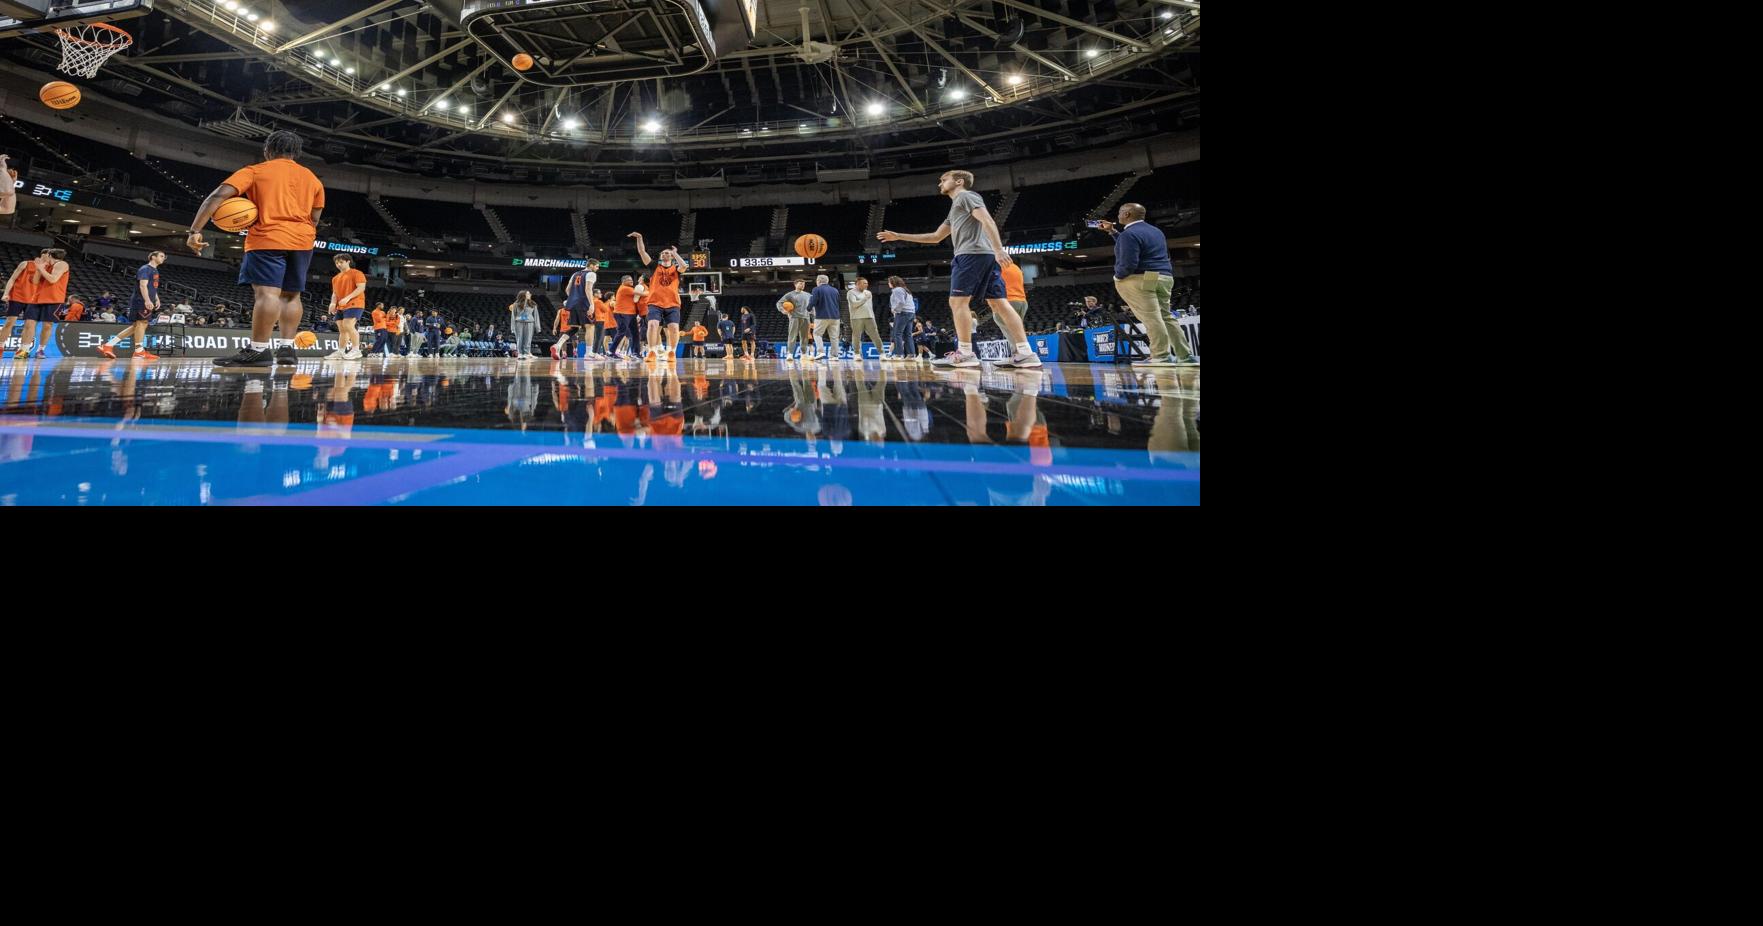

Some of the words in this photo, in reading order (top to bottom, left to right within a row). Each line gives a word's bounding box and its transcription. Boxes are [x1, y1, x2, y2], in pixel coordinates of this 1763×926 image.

[328, 242, 367, 254] ROUNDS
[730, 258, 738, 267] 0
[744, 258, 773, 267] 33:56
[182, 335, 227, 349] ROAD
[231, 337, 251, 349] TO
